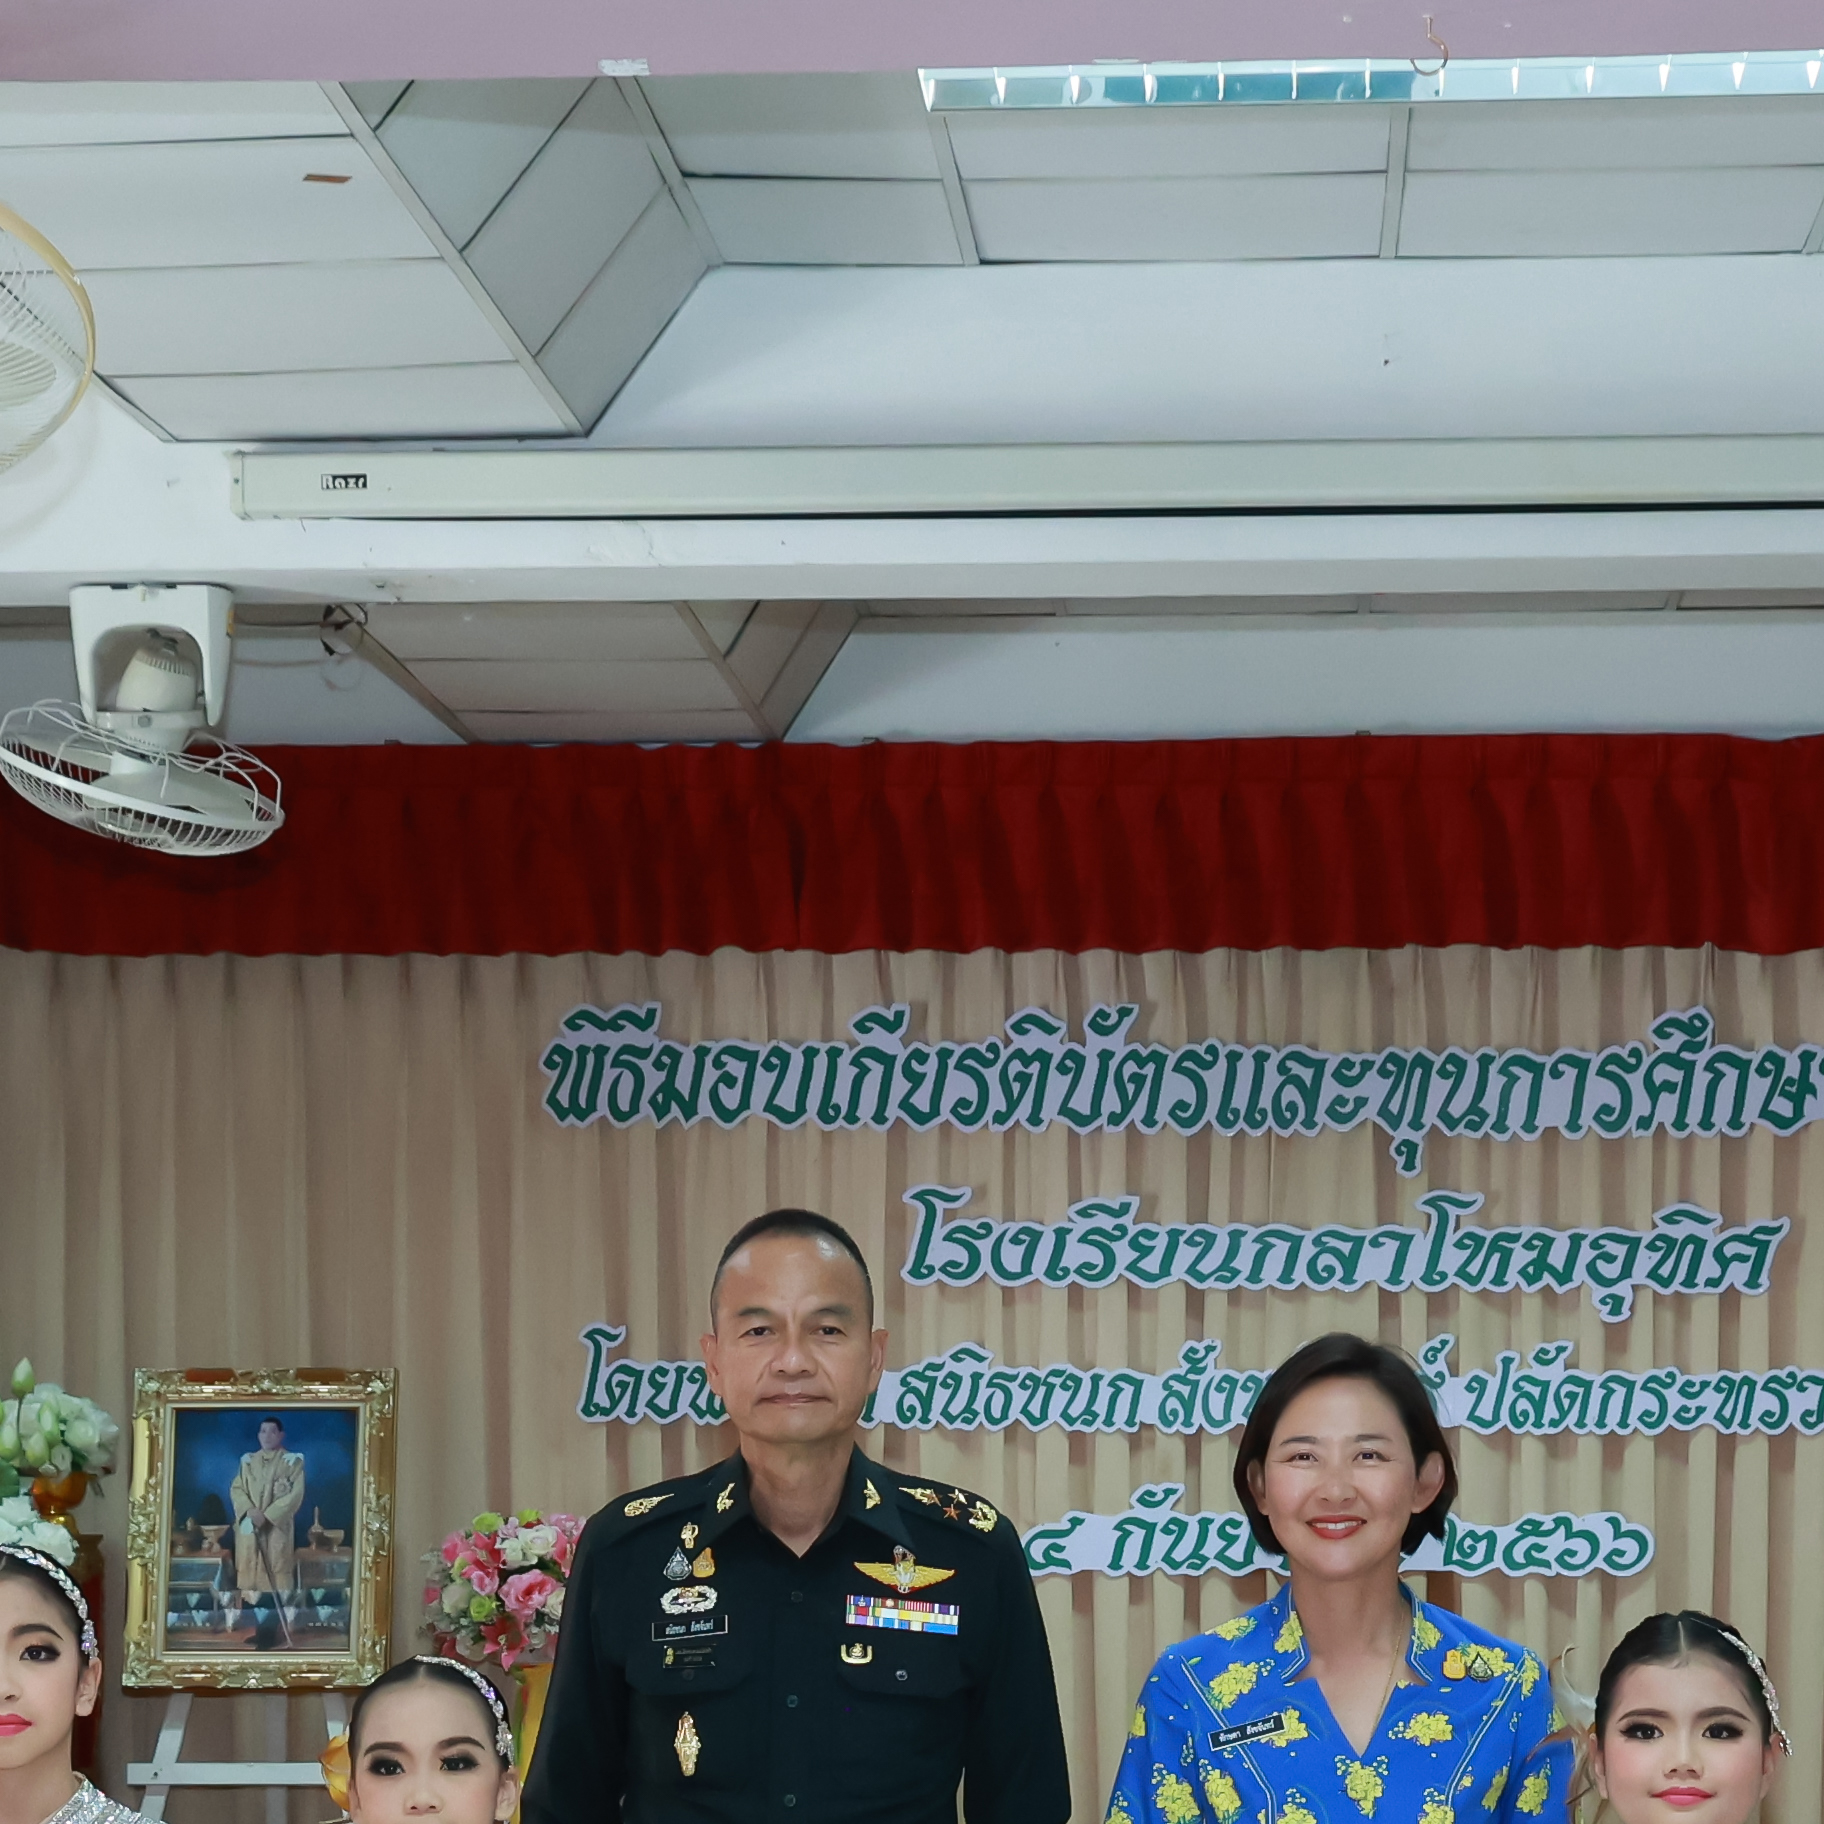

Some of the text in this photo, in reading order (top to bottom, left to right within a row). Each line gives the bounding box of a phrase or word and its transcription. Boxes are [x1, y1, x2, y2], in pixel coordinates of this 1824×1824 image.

[908, 1189, 1782, 1316] โรงเรียนกลาโหมอุทิศ
[898, 1347, 1144, 1427] สนิธชนก
[1442, 1515, 1650, 1571] ๒๕๖๖
